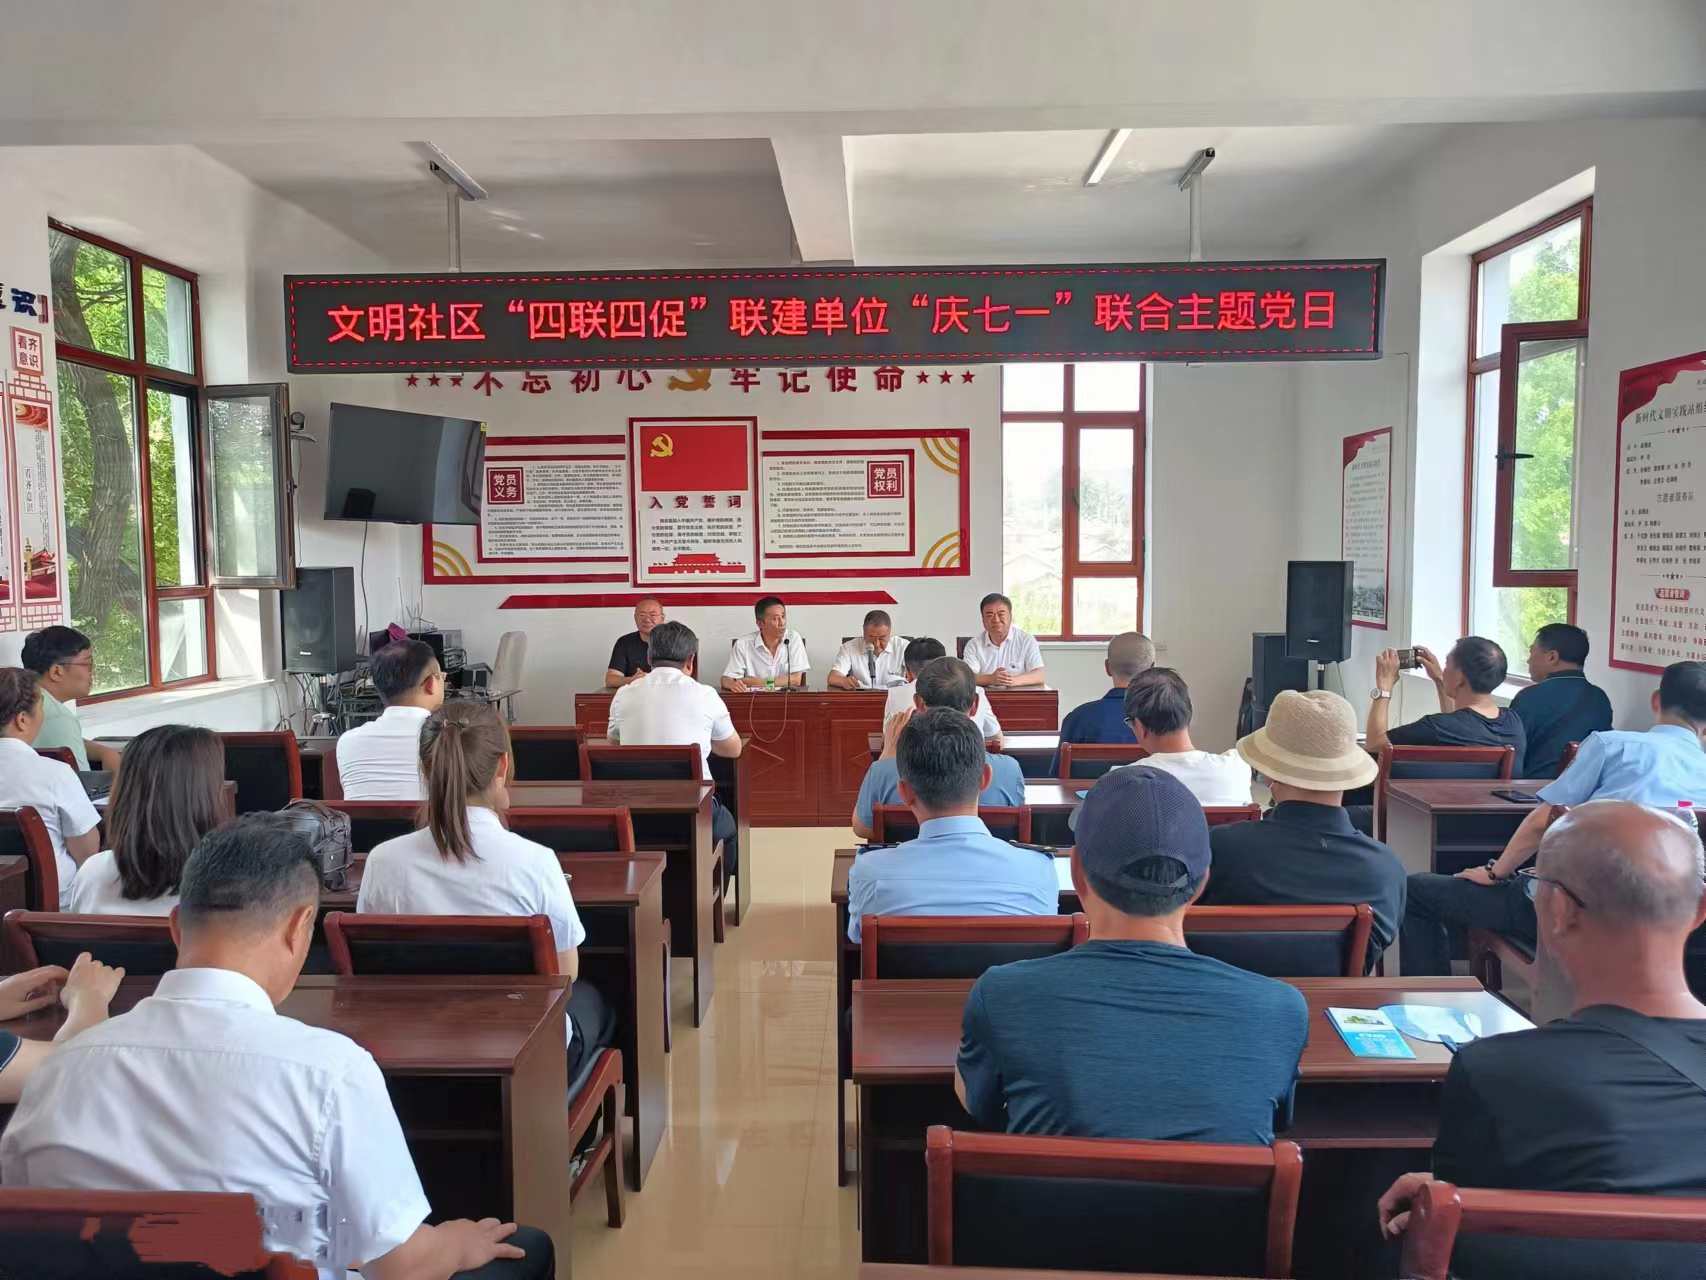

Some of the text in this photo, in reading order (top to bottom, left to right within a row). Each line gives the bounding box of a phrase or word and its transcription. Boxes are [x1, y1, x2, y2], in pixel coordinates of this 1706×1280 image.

[1635, 401, 1706, 424] 新时代文明实践站组
[873, 467, 897, 480] 党员
[493, 474, 517, 486] 党员
[873, 480, 898, 492] 权利
[494, 486, 517, 498] 义务
[649, 495, 742, 509] 入党誓词
